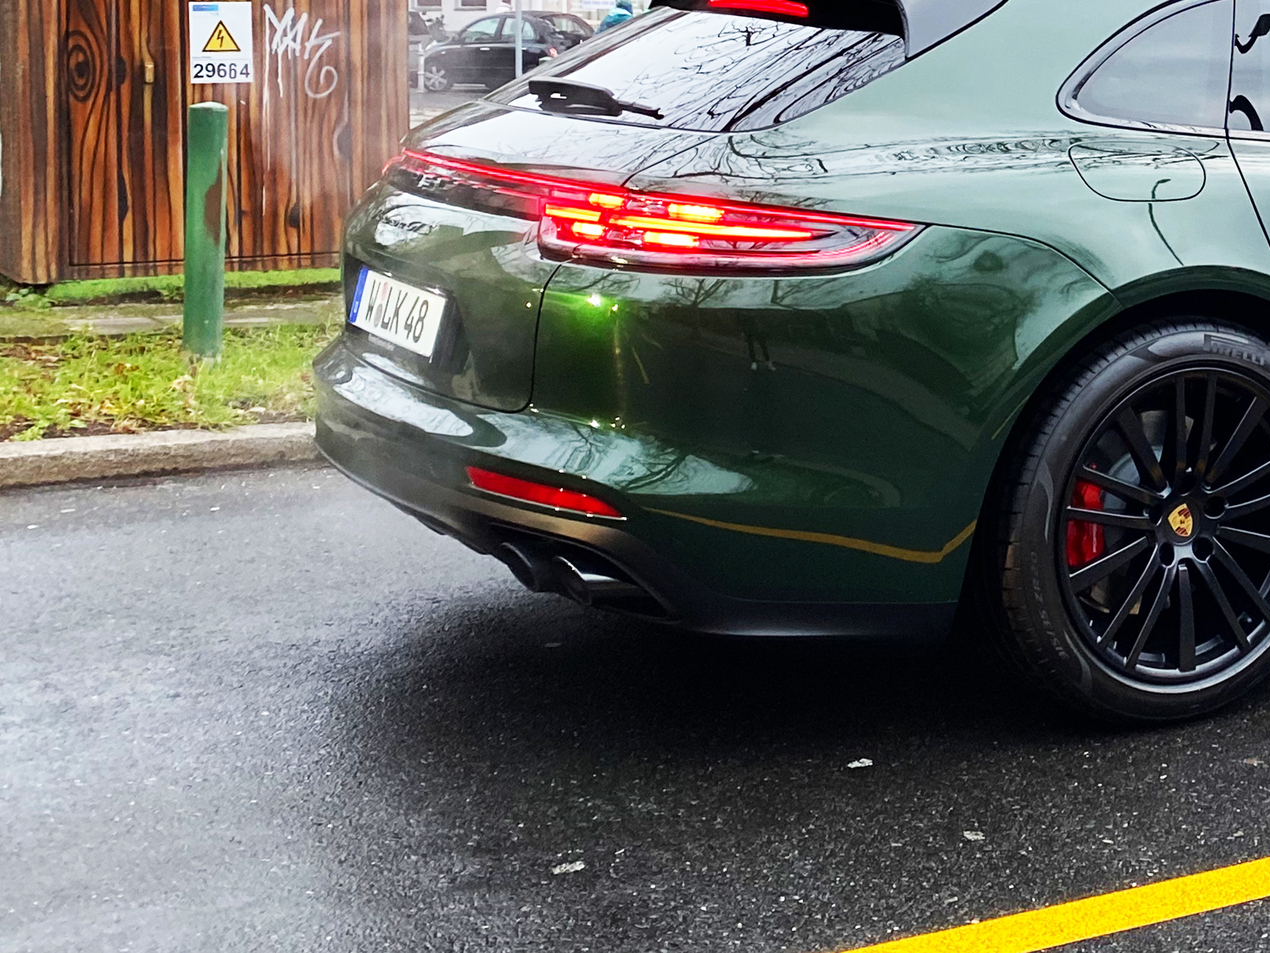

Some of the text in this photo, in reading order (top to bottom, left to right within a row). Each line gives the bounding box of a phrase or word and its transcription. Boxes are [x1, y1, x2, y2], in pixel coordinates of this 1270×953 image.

[193, 63, 250, 79] 29664
[365, 279, 429, 343] W LK 48
